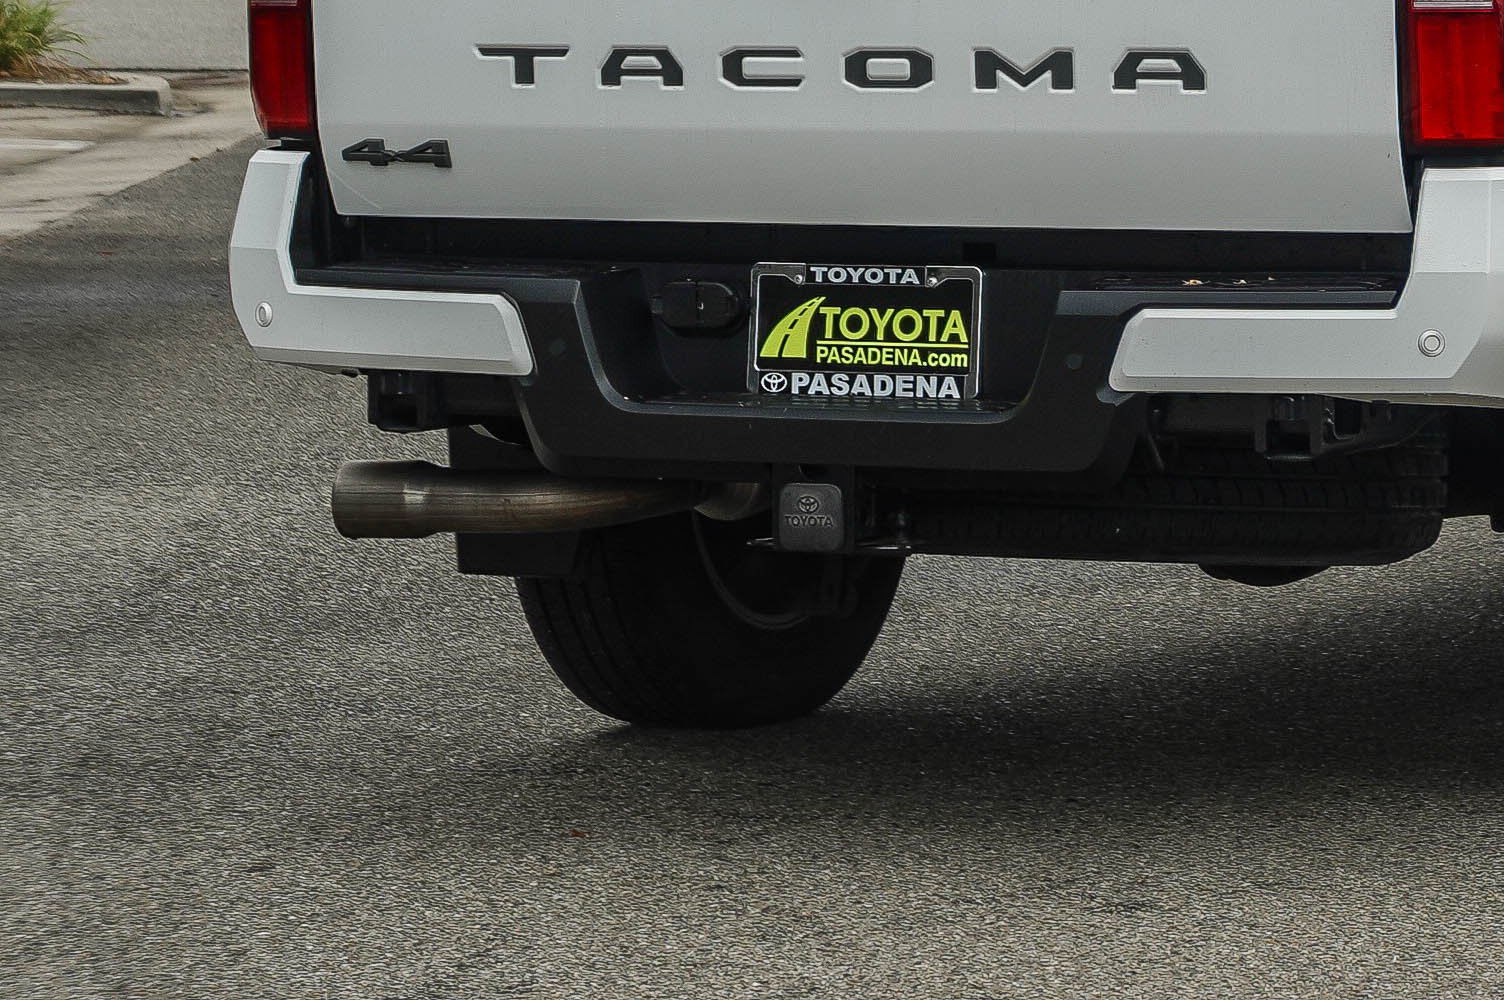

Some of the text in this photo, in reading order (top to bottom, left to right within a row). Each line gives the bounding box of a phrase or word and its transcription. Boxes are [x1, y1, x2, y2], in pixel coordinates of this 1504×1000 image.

[474, 45, 1206, 93] TACOMA
[809, 266, 920, 285] TOYOTA
[818, 306, 969, 343] TOYOTA
[816, 346, 968, 368] PASADENA.com
[791, 372, 961, 399] PASADENA
[784, 514, 834, 527] TOYOTA
